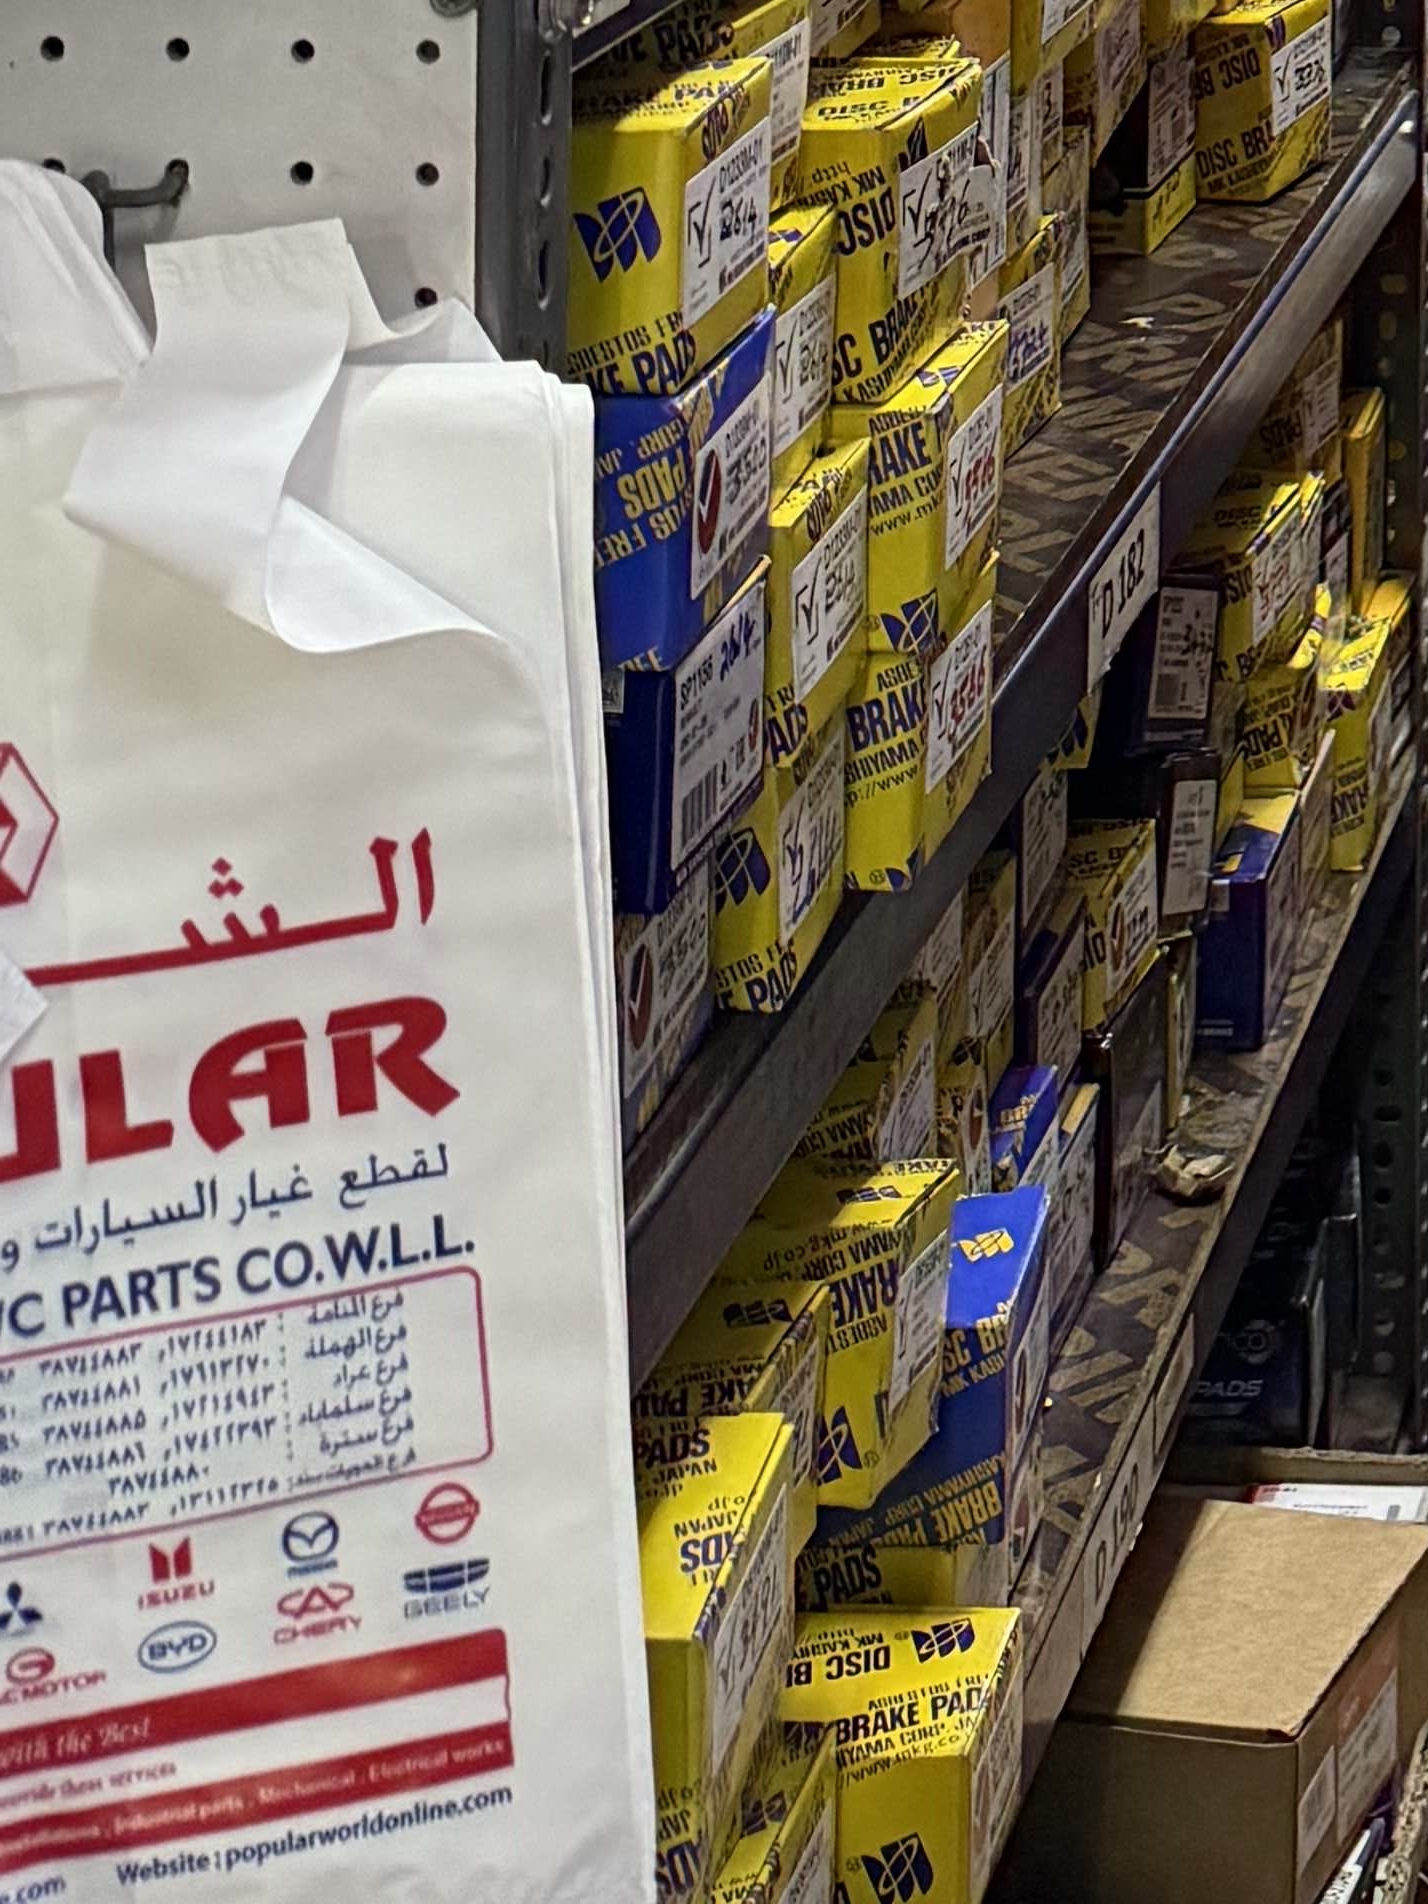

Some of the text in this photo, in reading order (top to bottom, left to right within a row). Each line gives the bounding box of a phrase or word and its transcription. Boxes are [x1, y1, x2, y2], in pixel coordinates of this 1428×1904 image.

[617, 452, 686, 521] PADS
[1102, 552, 1147, 636] D 182
[34, 1145, 449, 1254] لقطع غيار السيارات
[62, 1214, 476, 1328] PARTS CO.W.L.L.
[137, 1581, 216, 1608] ISUZU
[404, 1592, 490, 1621] GEELY
[148, 1633, 205, 1664] BYD
[273, 1614, 362, 1648] CHERY
[22, 1670, 106, 1701] MOTOR
[56, 1727, 91, 1754] the
[99, 1717, 151, 1748] Best
[836, 1697, 921, 1744] BRAKE
[454, 1738, 504, 1763] works
[109, 1761, 177, 1787] services
[116, 1784, 513, 1886] Website popularworldonline.com
